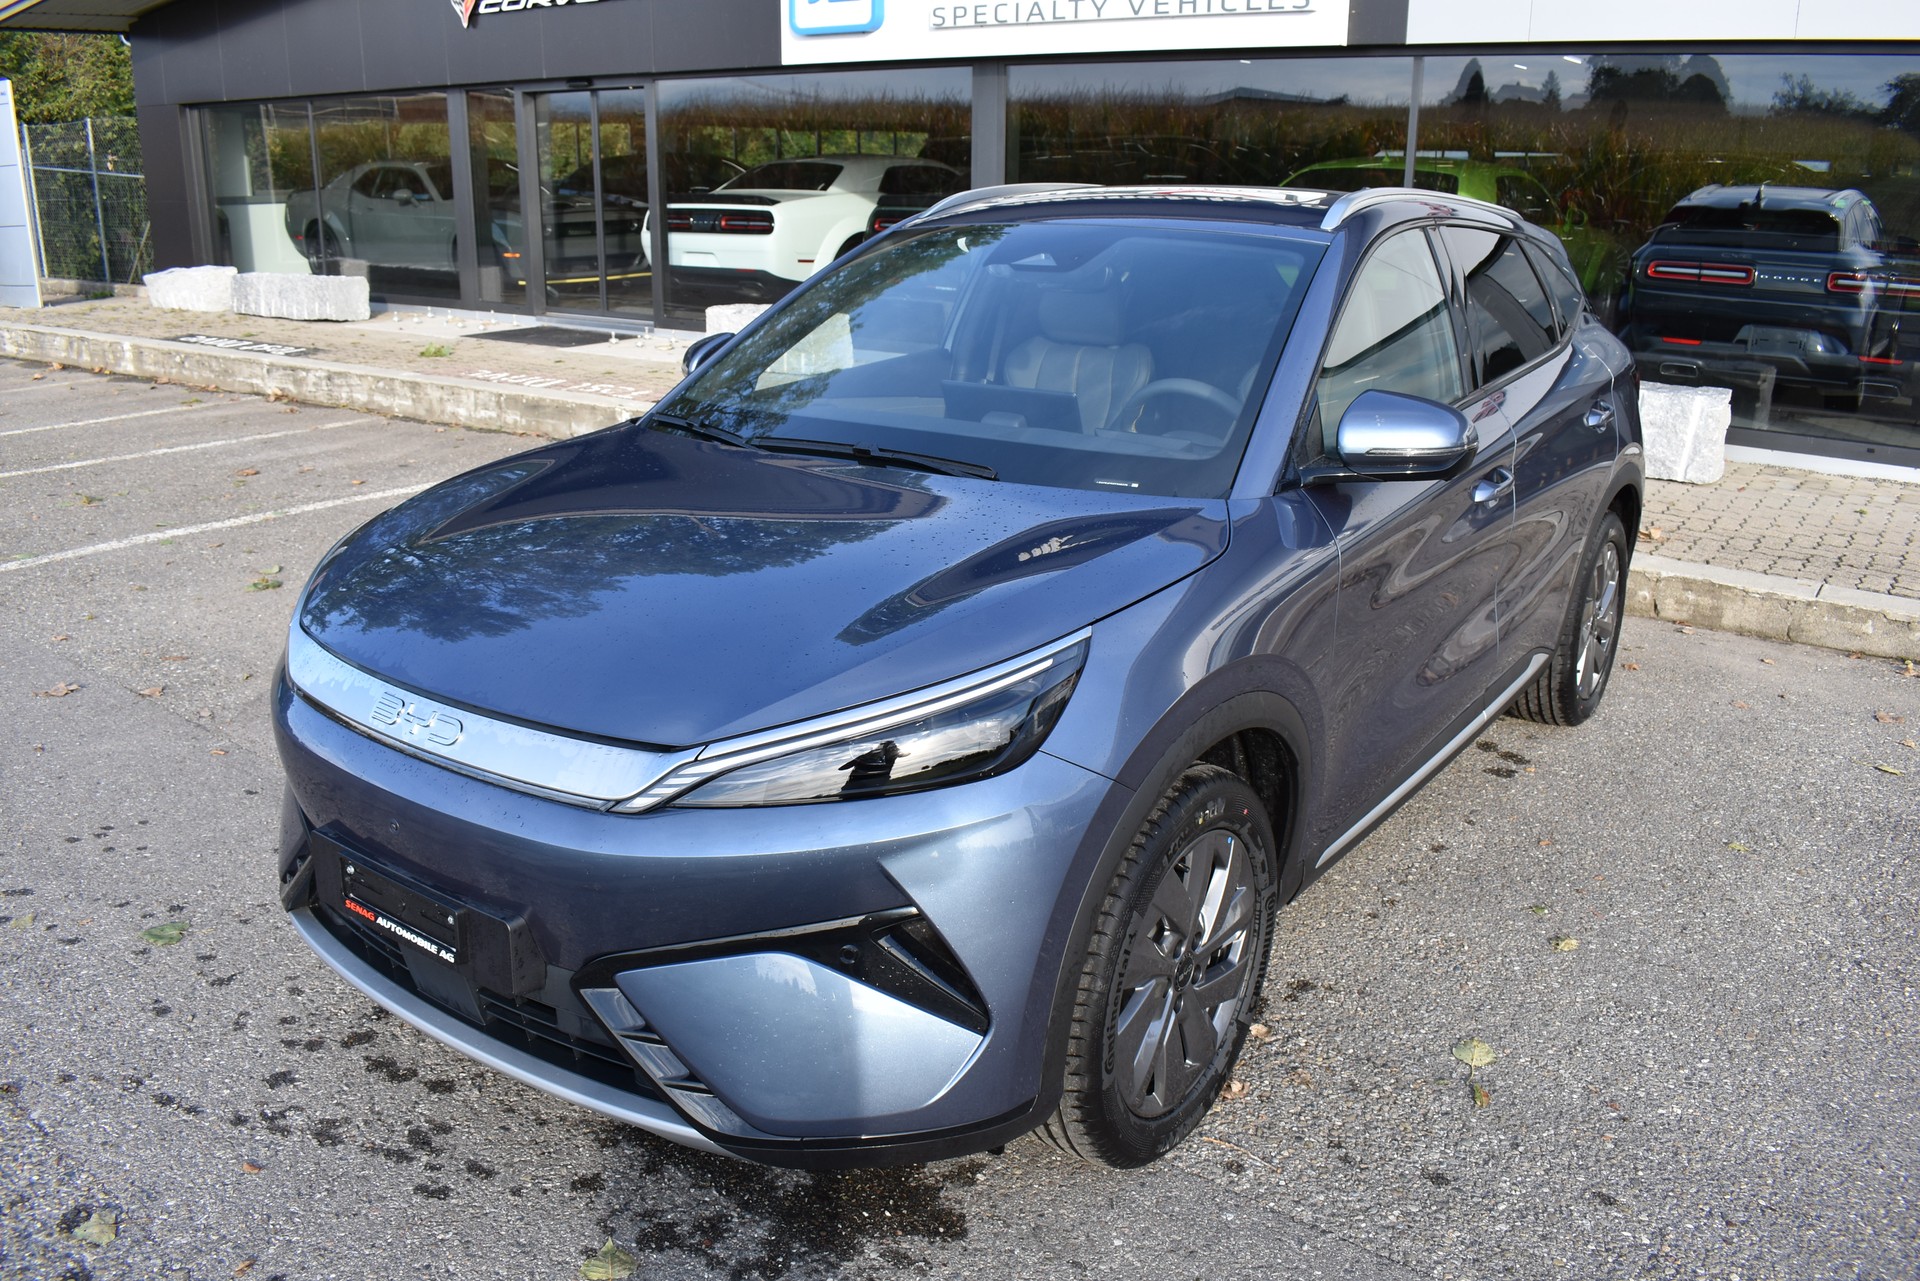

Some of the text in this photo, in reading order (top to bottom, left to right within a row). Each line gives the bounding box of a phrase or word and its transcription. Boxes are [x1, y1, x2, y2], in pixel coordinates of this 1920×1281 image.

[932, 0, 1107, 27] SPECIALTY
[371, 691, 464, 746] BYD
[345, 899, 455, 964] SENAG AUTOMOBILE AG
